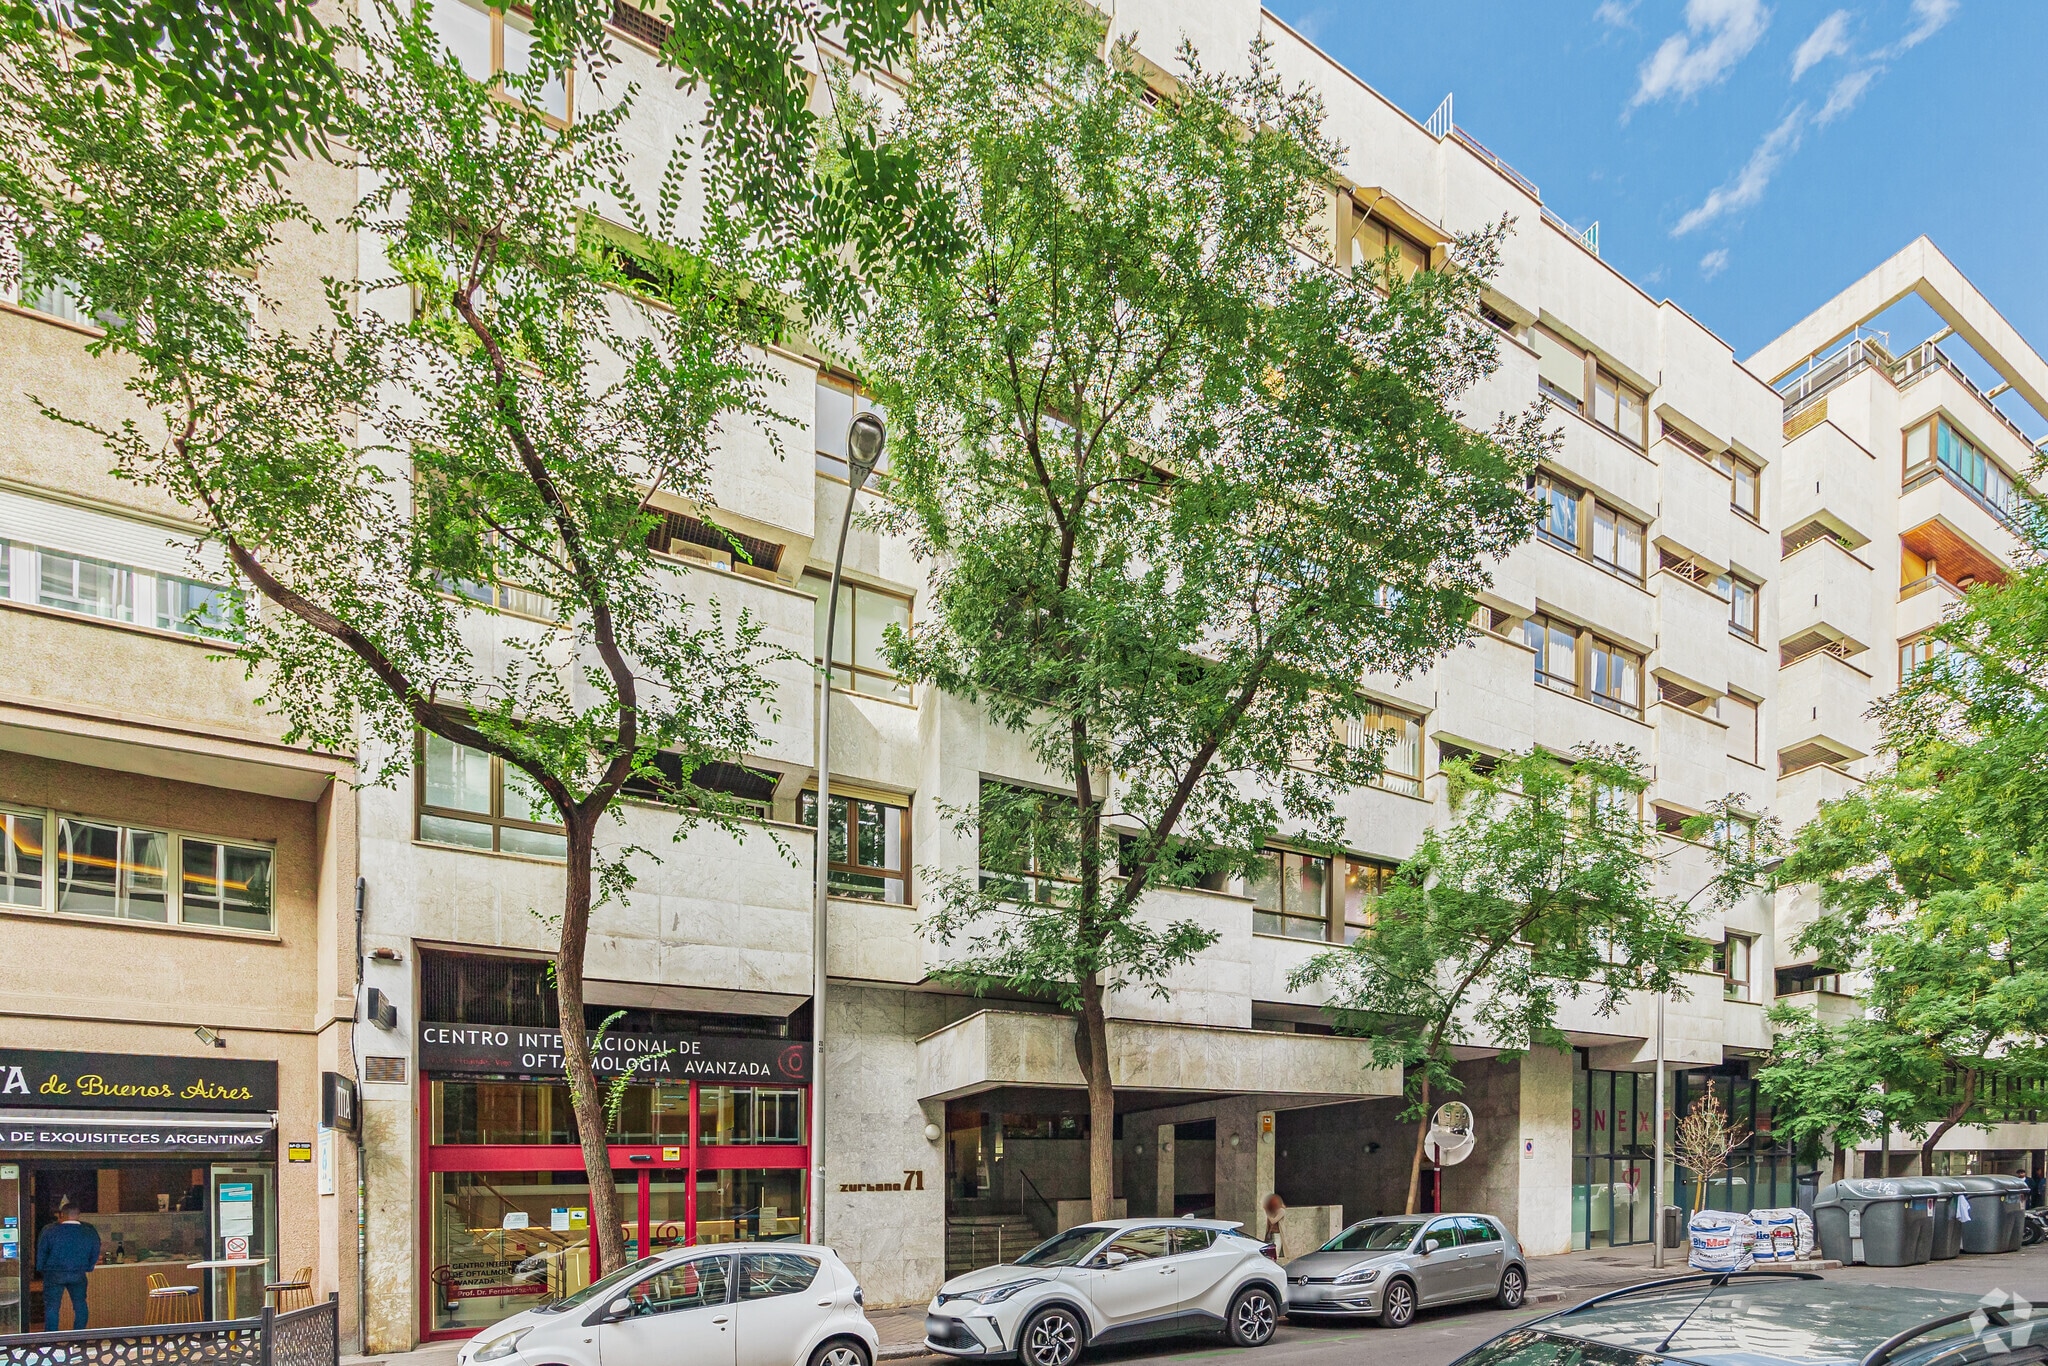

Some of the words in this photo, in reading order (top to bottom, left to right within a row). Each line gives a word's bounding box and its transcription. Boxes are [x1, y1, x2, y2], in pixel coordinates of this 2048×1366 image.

[424, 1028, 508, 1046] CENTRO
[519, 1033, 669, 1054] INTEACIONAL
[680, 1041, 700, 1054] DE
[522, 1053, 671, 1073] OFTAMOLOGIA
[685, 1060, 771, 1076] AVANZADA
[40, 1074, 71, 1095] de
[76, 1074, 175, 1097] Buenos
[180, 1078, 254, 1100] Aires
[10, 1132, 35, 1142] DE
[40, 1132, 160, 1144] EXQUISITECES
[164, 1134, 264, 1144] ARGENTINAS
[903, 1170, 925, 1191] 71
[452, 1261, 484, 1270] CENTRO
[453, 1278, 496, 1286] AVANZADA
[477, 1288, 487, 1296] Dr.
